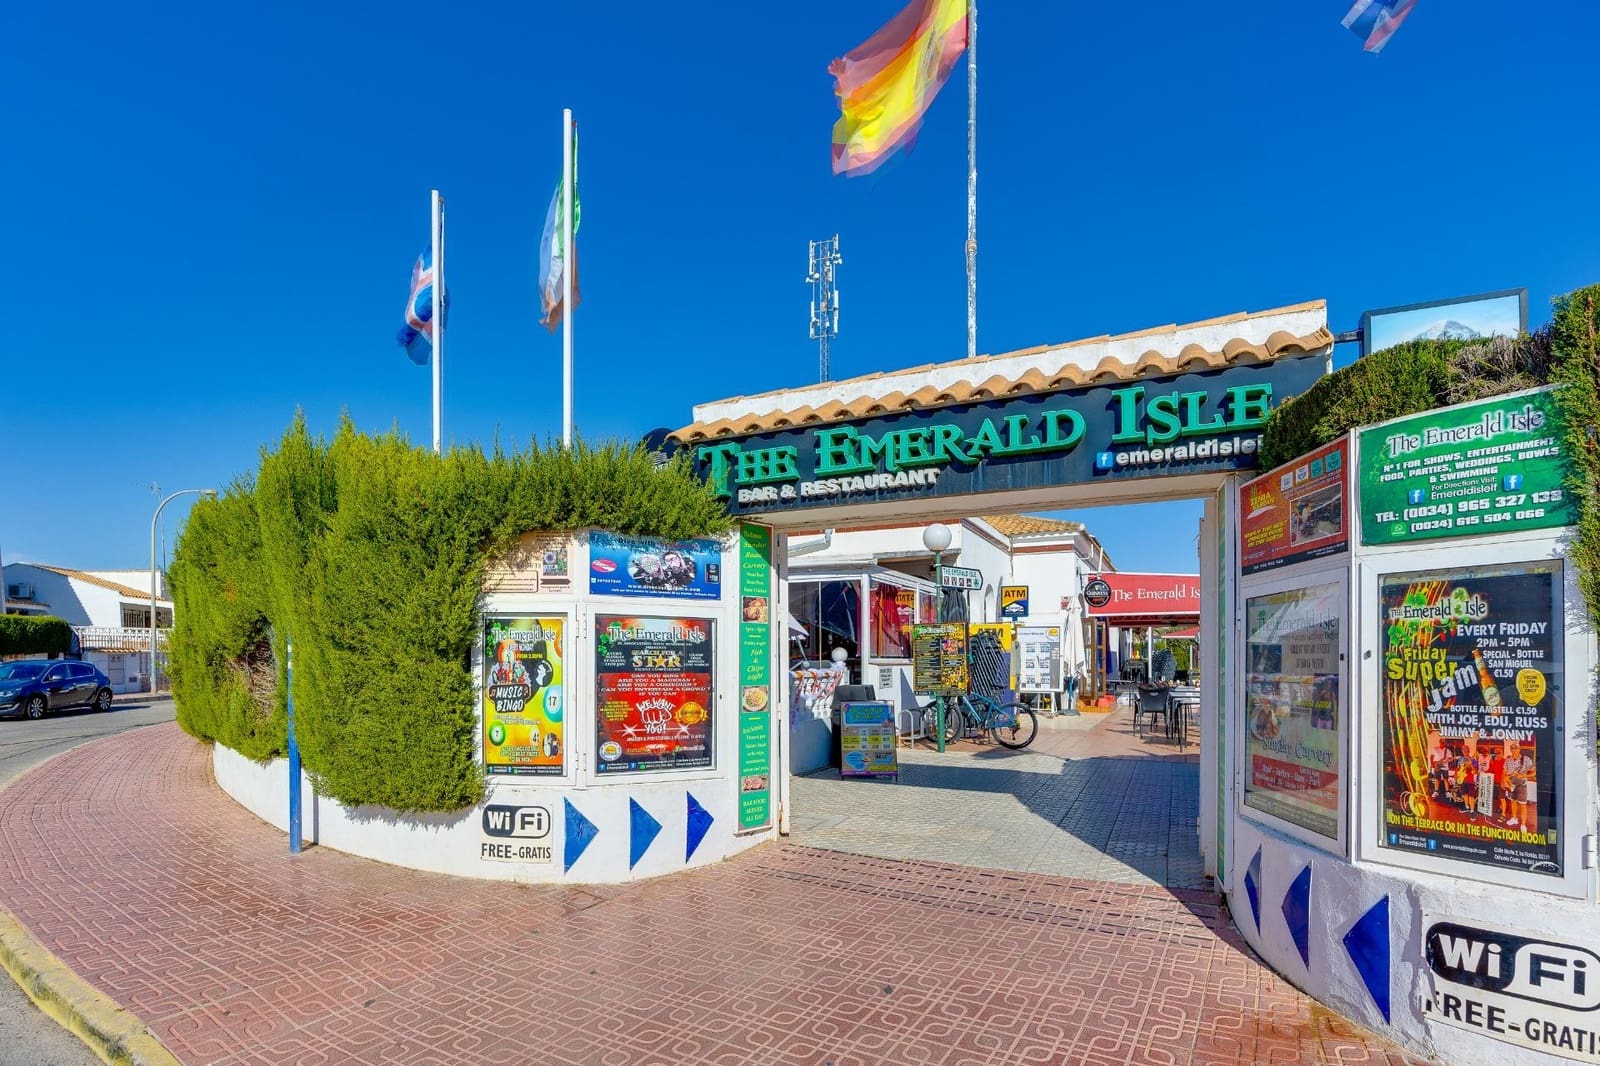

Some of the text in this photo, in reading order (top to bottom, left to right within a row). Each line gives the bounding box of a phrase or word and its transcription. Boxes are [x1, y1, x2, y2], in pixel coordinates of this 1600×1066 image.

[1389, 405, 1543, 457] The Emerald Isle
[698, 383, 1273, 498] THE EMERALD ISLE
[1403, 460, 1421, 470] FOR
[1424, 452, 1463, 466] SHOWS,
[1467, 437, 1555, 459] ENTERTAINMENT
[1380, 447, 1560, 483] FOOD, PARTIES, WEDDINGS, BOWLS
[1430, 467, 1499, 483] & SWIMMING
[738, 468, 941, 503] BAR & RESTAURANT
[1431, 484, 1442, 492] For
[1376, 512, 1399, 523] TEL:
[1403, 503, 1453, 521] (0034)
[1457, 499, 1490, 513] 965
[1495, 494, 1527, 508] 327
[1411, 508, 1545, 533] (0034) 615 504 066
[1004, 590, 1026, 598] ATM
[1112, 589, 1133, 602] The
[1137, 584, 1186, 600] Emerald
[1391, 596, 1486, 619] THE Emerald Isle
[493, 625, 556, 642] The Emerald Isle
[608, 625, 705, 644] The Emerald Isle
[1457, 622, 1547, 636] EVERY FRIDAY
[1477, 638, 1498, 648] 2PM
[1507, 637, 1530, 648] 5PM
[1403, 647, 1447, 664] Friday
[1482, 650, 1511, 659] SPECIAL
[1517, 649, 1544, 659] BOTTLE
[1387, 657, 1458, 687] Super
[1488, 659, 1533, 669] SAN MIGUEL
[1494, 669, 1513, 679] €1.50
[496, 685, 523, 698] MUSIC
[496, 699, 523, 712] BINGO
[549, 695, 557, 706] 17
[635, 701, 652, 712] WE
[652, 697, 677, 711] WANT
[1451, 705, 1537, 715] BOTTLE AMSTELL €1.50
[1427, 713, 1548, 729] WITH JOE, EDU, RUSS
[1440, 726, 1534, 741] JIMMY & JONNY
[1402, 816, 1415, 827] THE
[1416, 817, 1444, 831] TERRACE
[1445, 823, 1456, 833] OR
[1457, 823, 1467, 834] IN
[1467, 824, 1481, 836] THE
[1482, 826, 1521, 843] FUNCTION
[1522, 831, 1546, 845] ROOM
[481, 843, 551, 859] FREE-GRATIS
